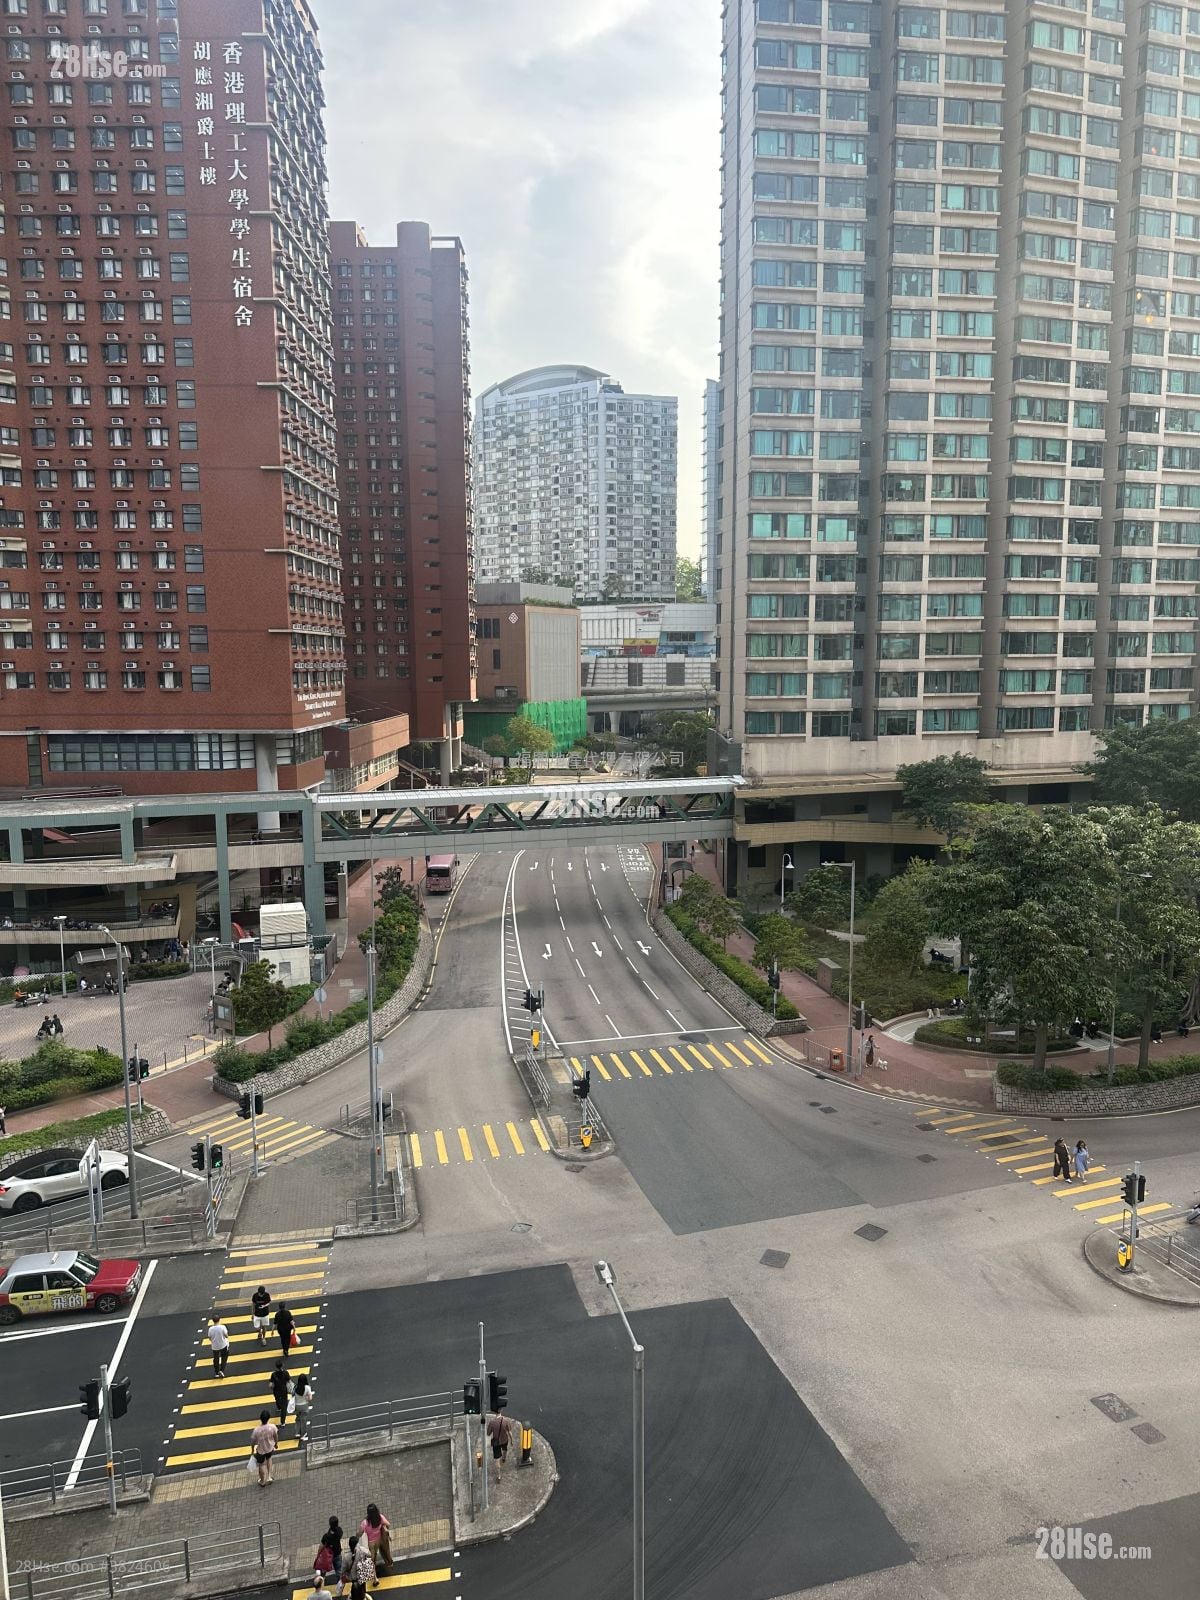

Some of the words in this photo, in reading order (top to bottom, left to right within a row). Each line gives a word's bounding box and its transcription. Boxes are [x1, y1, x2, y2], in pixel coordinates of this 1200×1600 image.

[193, 41, 217, 186] 胡應湘爵士樓
[222, 41, 254, 327] 香港理工大學學生宿舍
